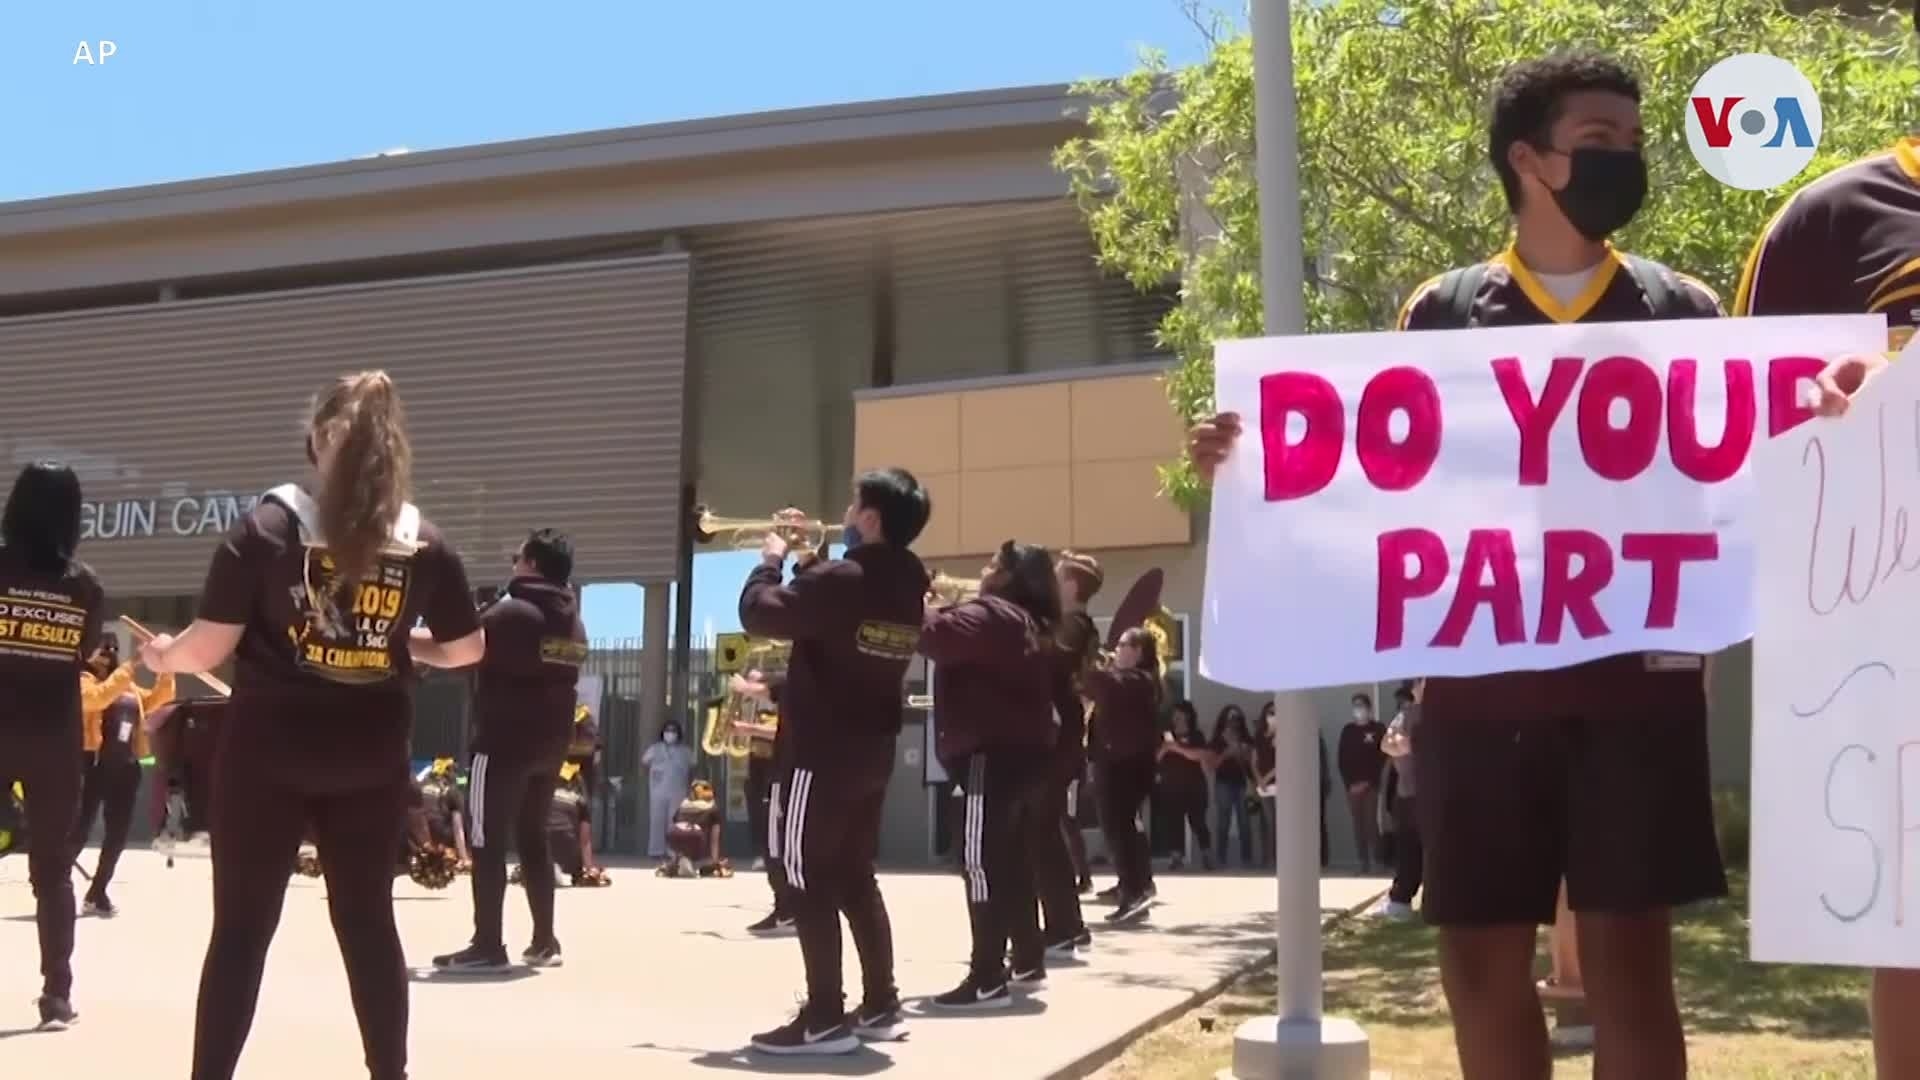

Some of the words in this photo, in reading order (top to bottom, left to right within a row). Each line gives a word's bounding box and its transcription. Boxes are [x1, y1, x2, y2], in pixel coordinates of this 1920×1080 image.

[1260, 366, 1442, 501] DO
[20, 622, 81, 646] RESULTS
[1374, 527, 1719, 652] PART
